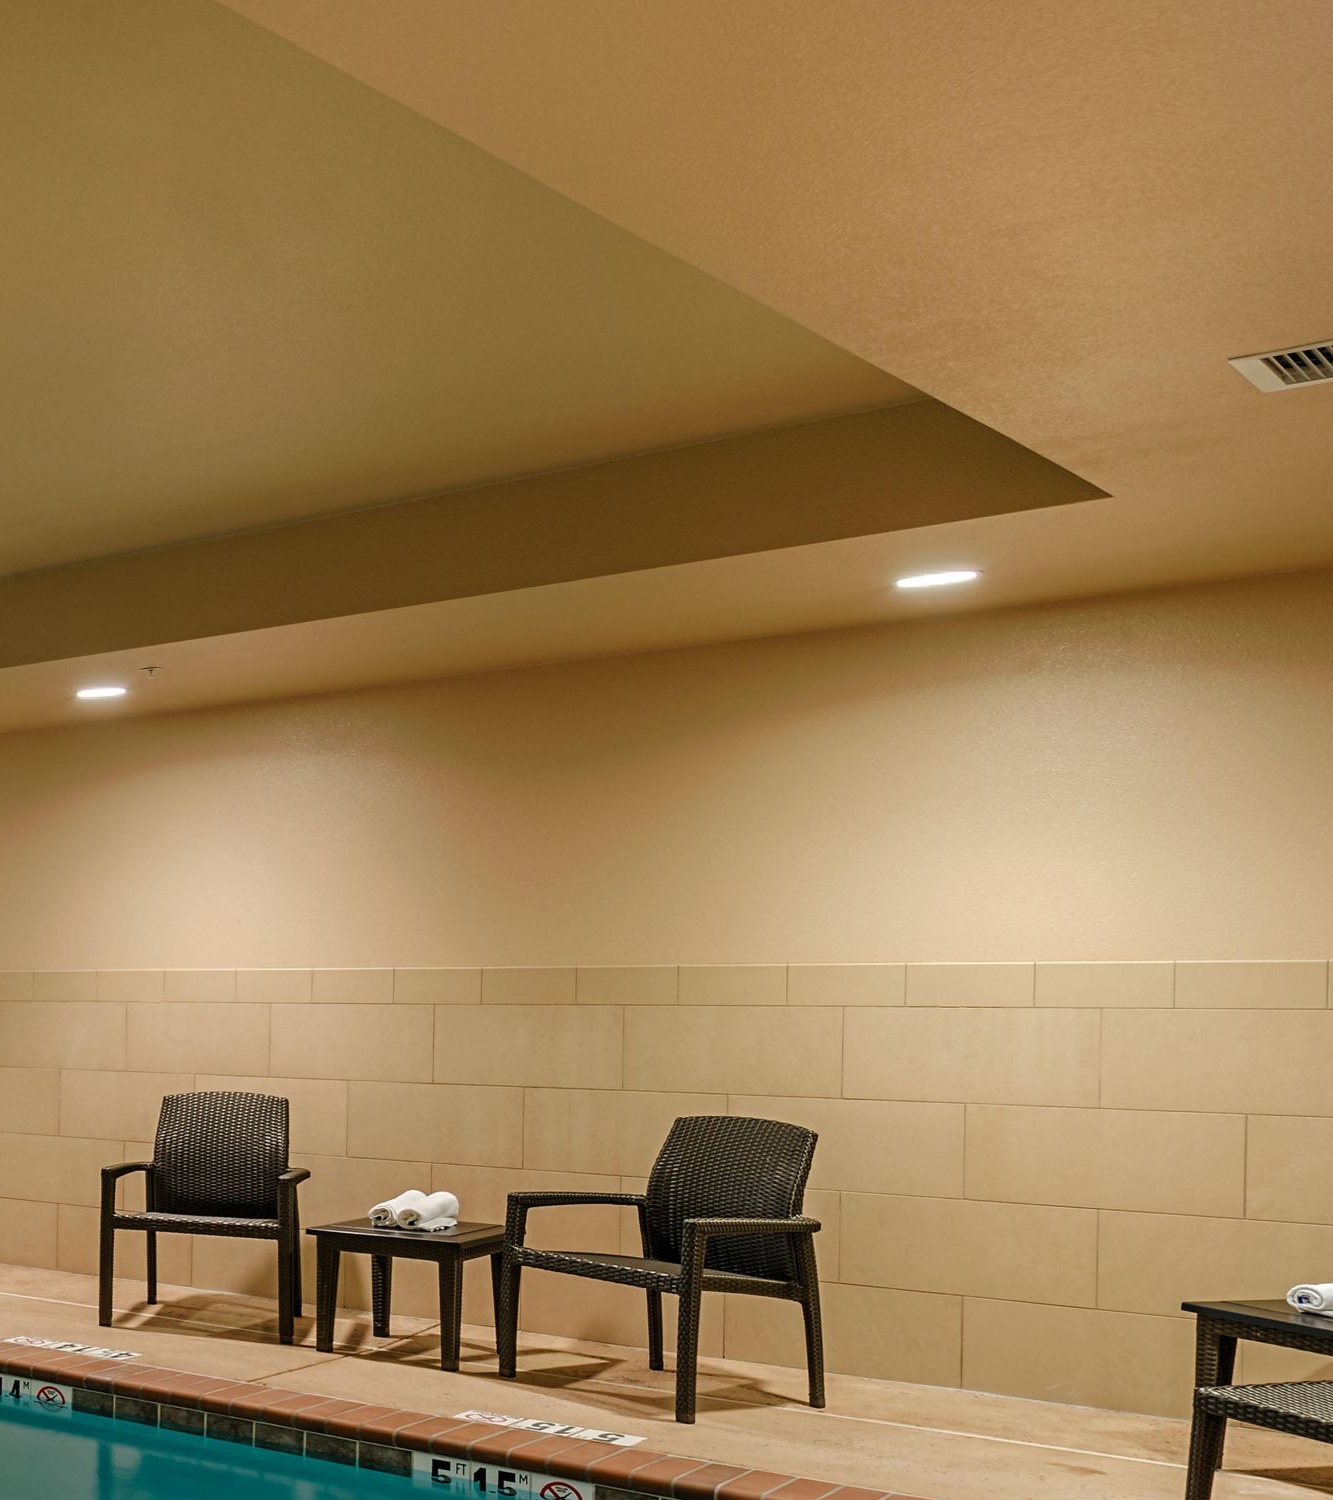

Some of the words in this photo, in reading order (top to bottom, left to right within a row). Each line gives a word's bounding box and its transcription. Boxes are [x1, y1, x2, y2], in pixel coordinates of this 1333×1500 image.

[431, 1459, 451, 1484] 5
[456, 1463, 467, 1476] FT
[473, 1467, 517, 1497] 1.5
[519, 1474, 528, 1485] M
